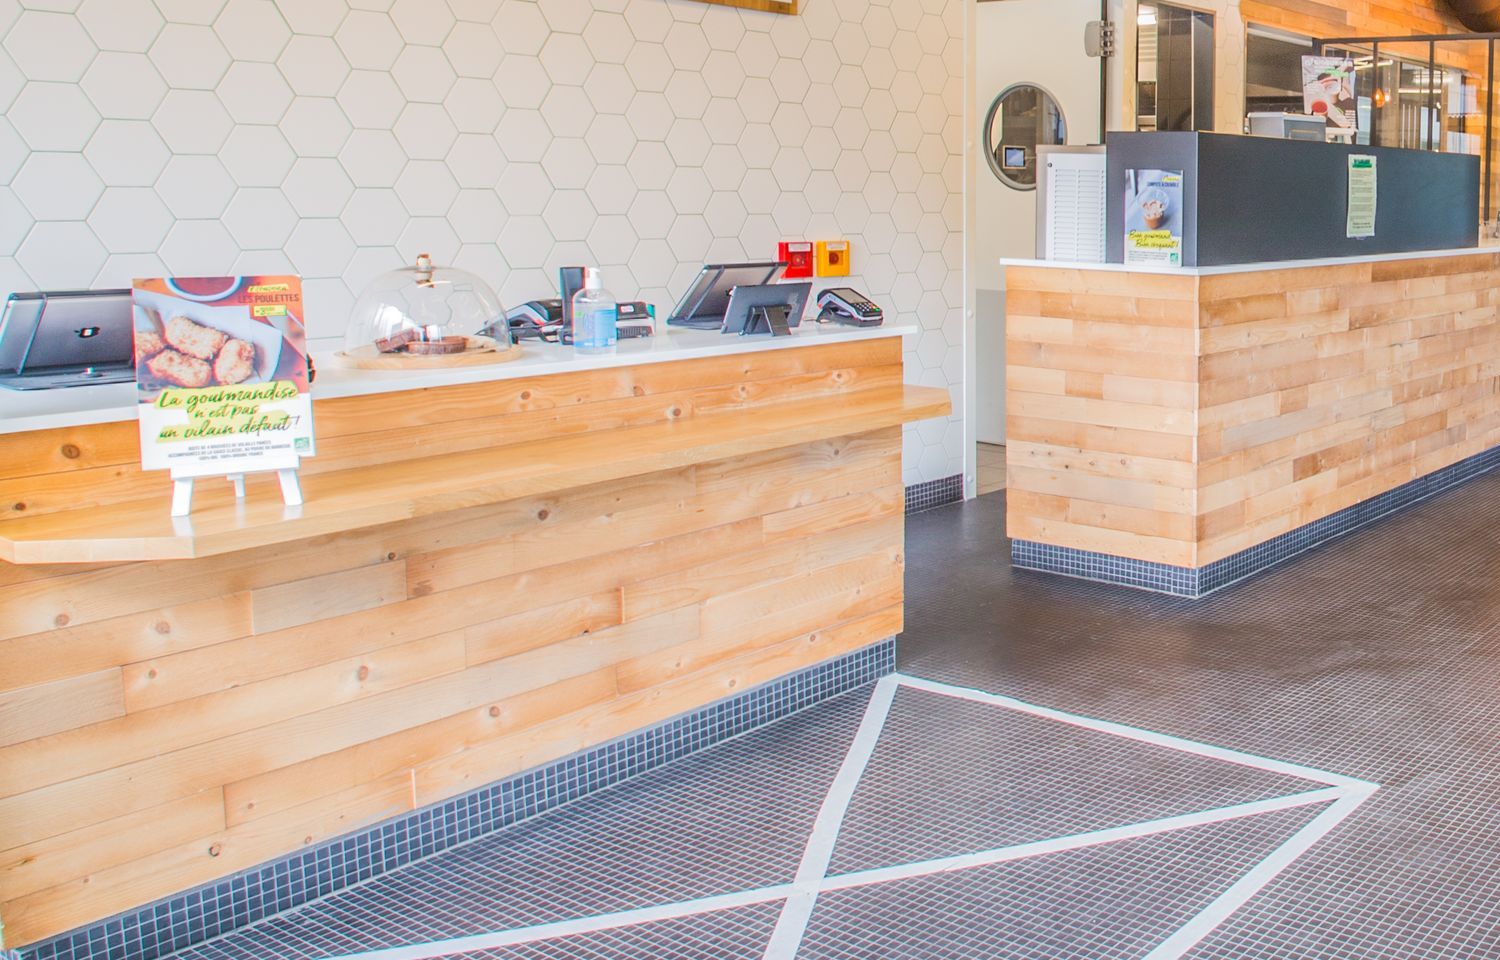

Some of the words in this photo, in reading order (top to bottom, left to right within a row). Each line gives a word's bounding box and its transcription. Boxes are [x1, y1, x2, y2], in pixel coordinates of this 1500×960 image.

[254, 293, 300, 304] POULETTES
[159, 391, 182, 408] La
[186, 382, 299, 414] gourmandise
[231, 403, 261, 420] pas
[159, 428, 178, 439] un
[184, 422, 235, 439] vilain
[239, 415, 291, 437] défaut
